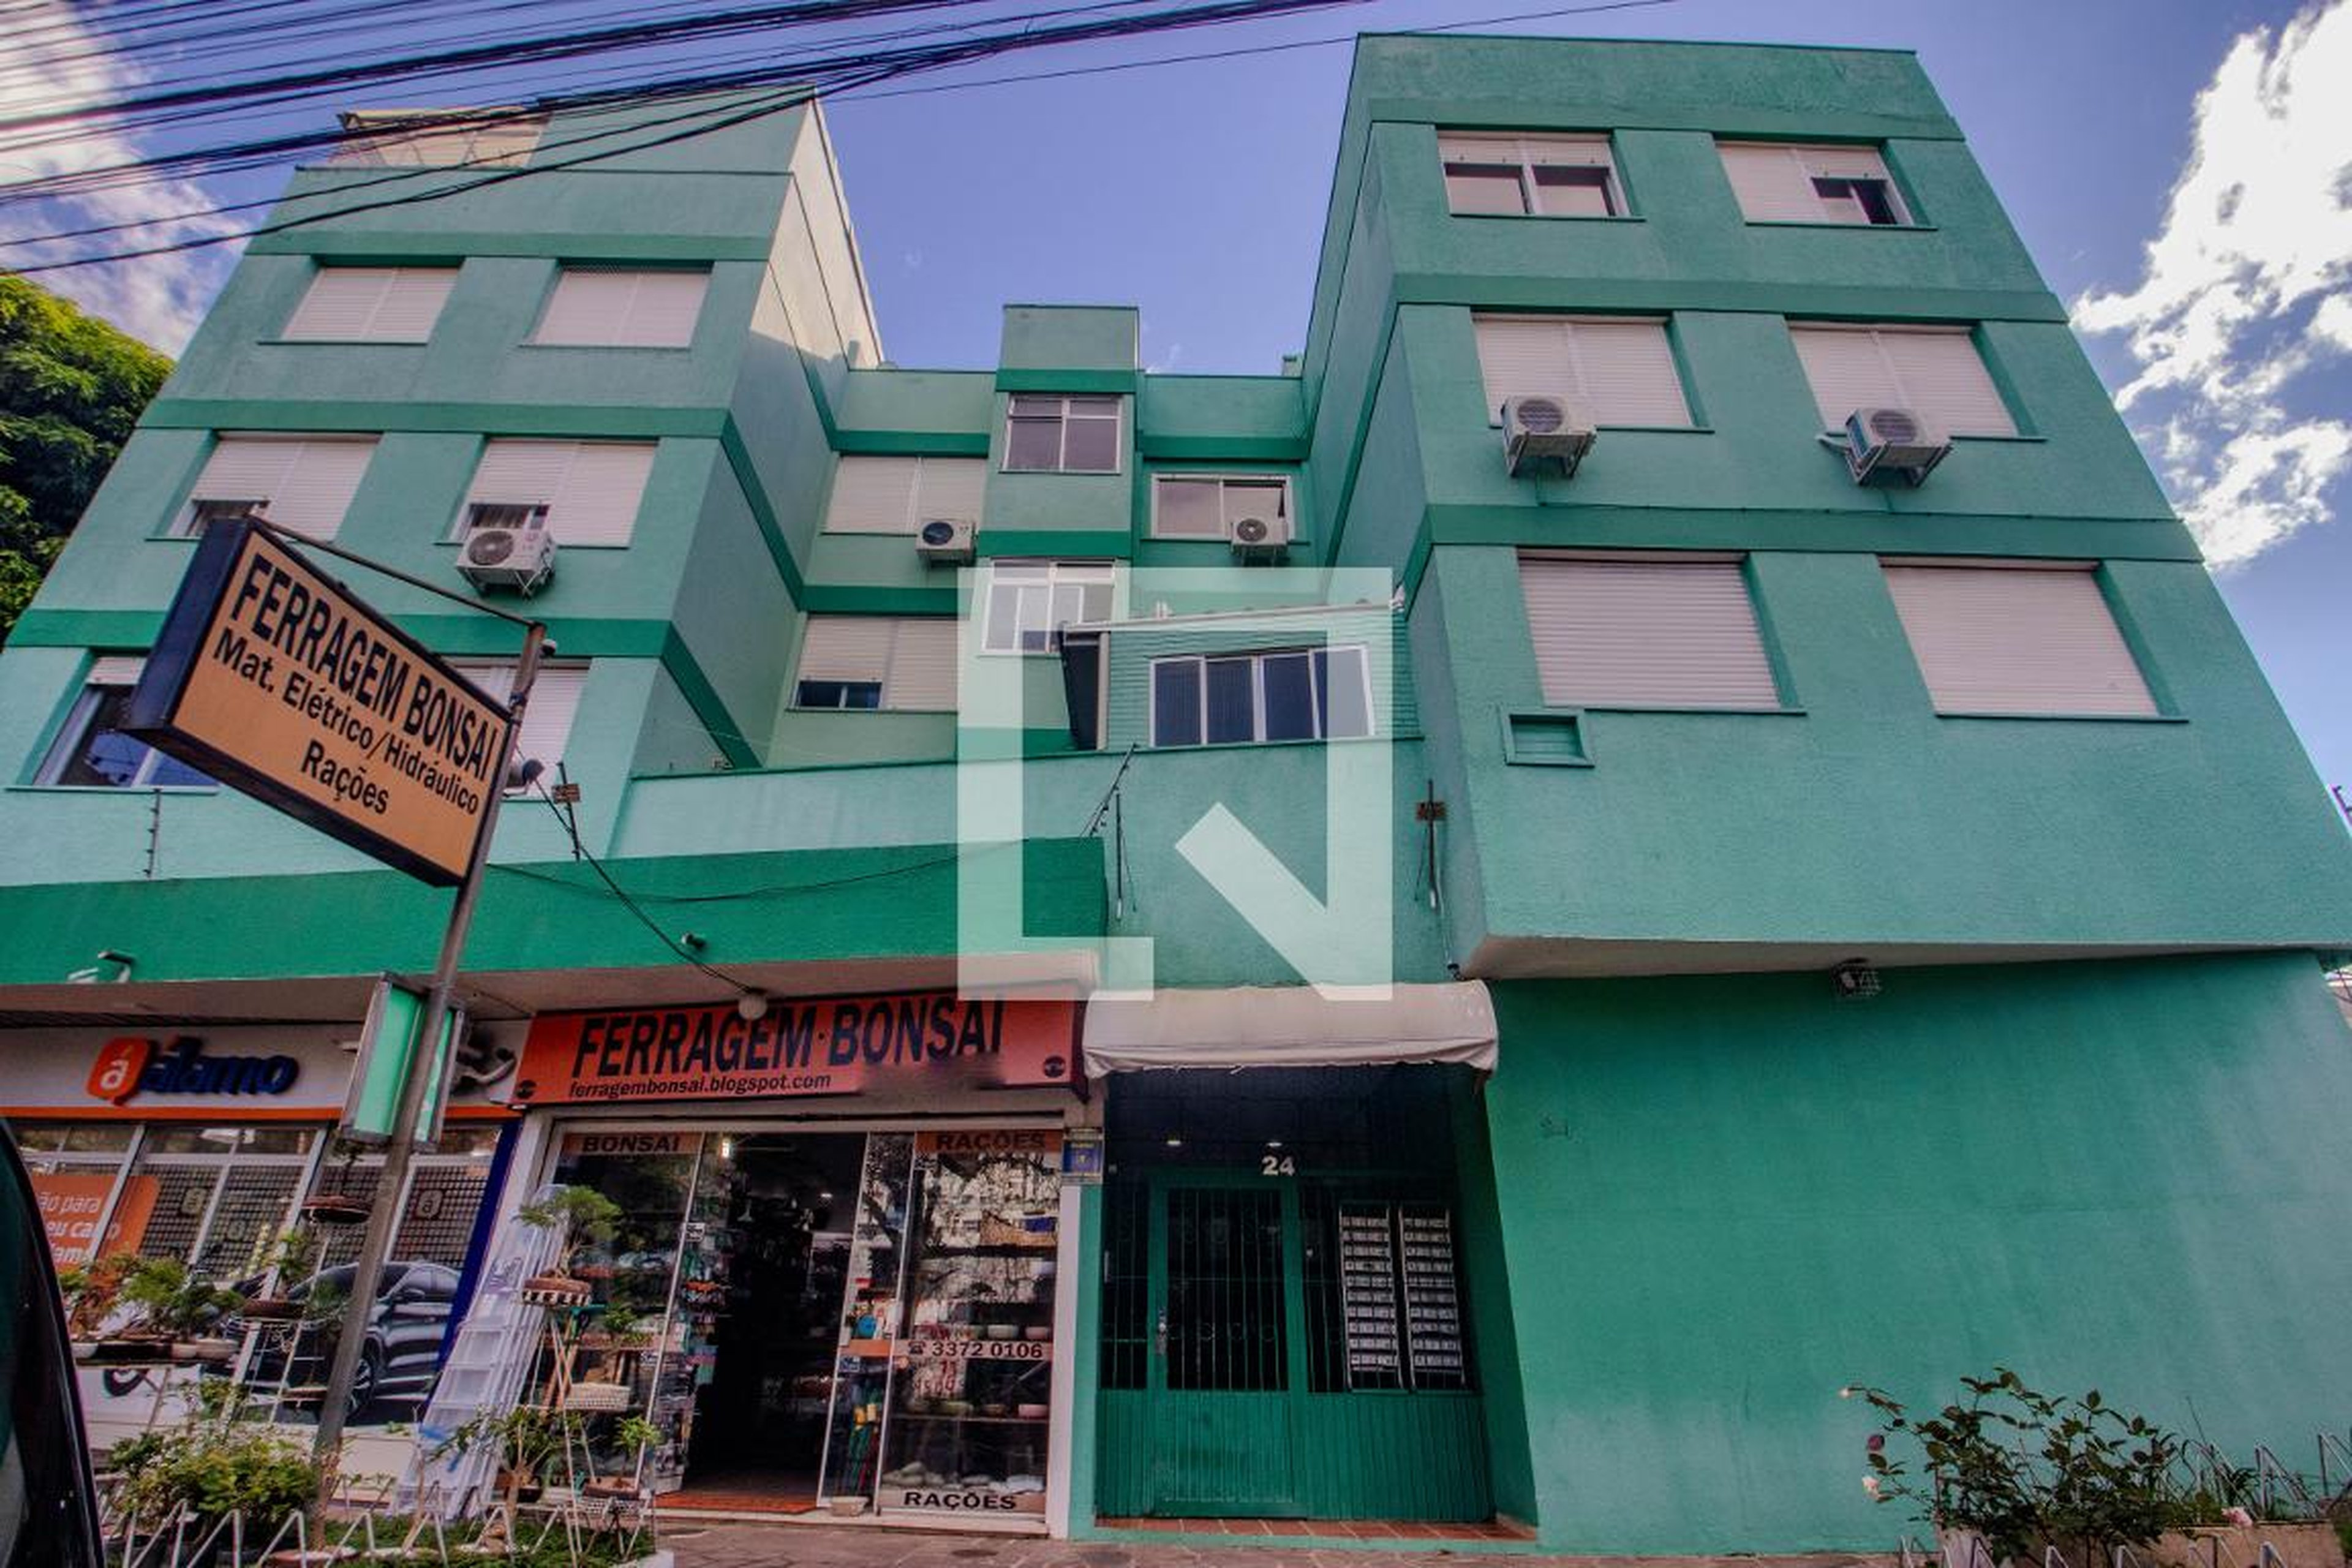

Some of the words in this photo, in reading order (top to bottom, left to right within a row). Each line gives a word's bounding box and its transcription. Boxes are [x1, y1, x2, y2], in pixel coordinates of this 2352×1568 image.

[214, 627, 274, 693] Mat.
[231, 552, 410, 722] FERRAGEM
[403, 674, 498, 782] BONSAI
[301, 738, 390, 814] Rações
[571, 1005, 816, 1078] FERRAGEM
[829, 995, 1005, 1066] BONSAI
[568, 1074, 832, 1100] ferragembonsai.blogspot.com
[582, 1134, 680, 1153] BONSAI
[1262, 1156, 1295, 1176] 24
[932, 1341, 983, 1357] 3372
[991, 1343, 1043, 1359] 0106
